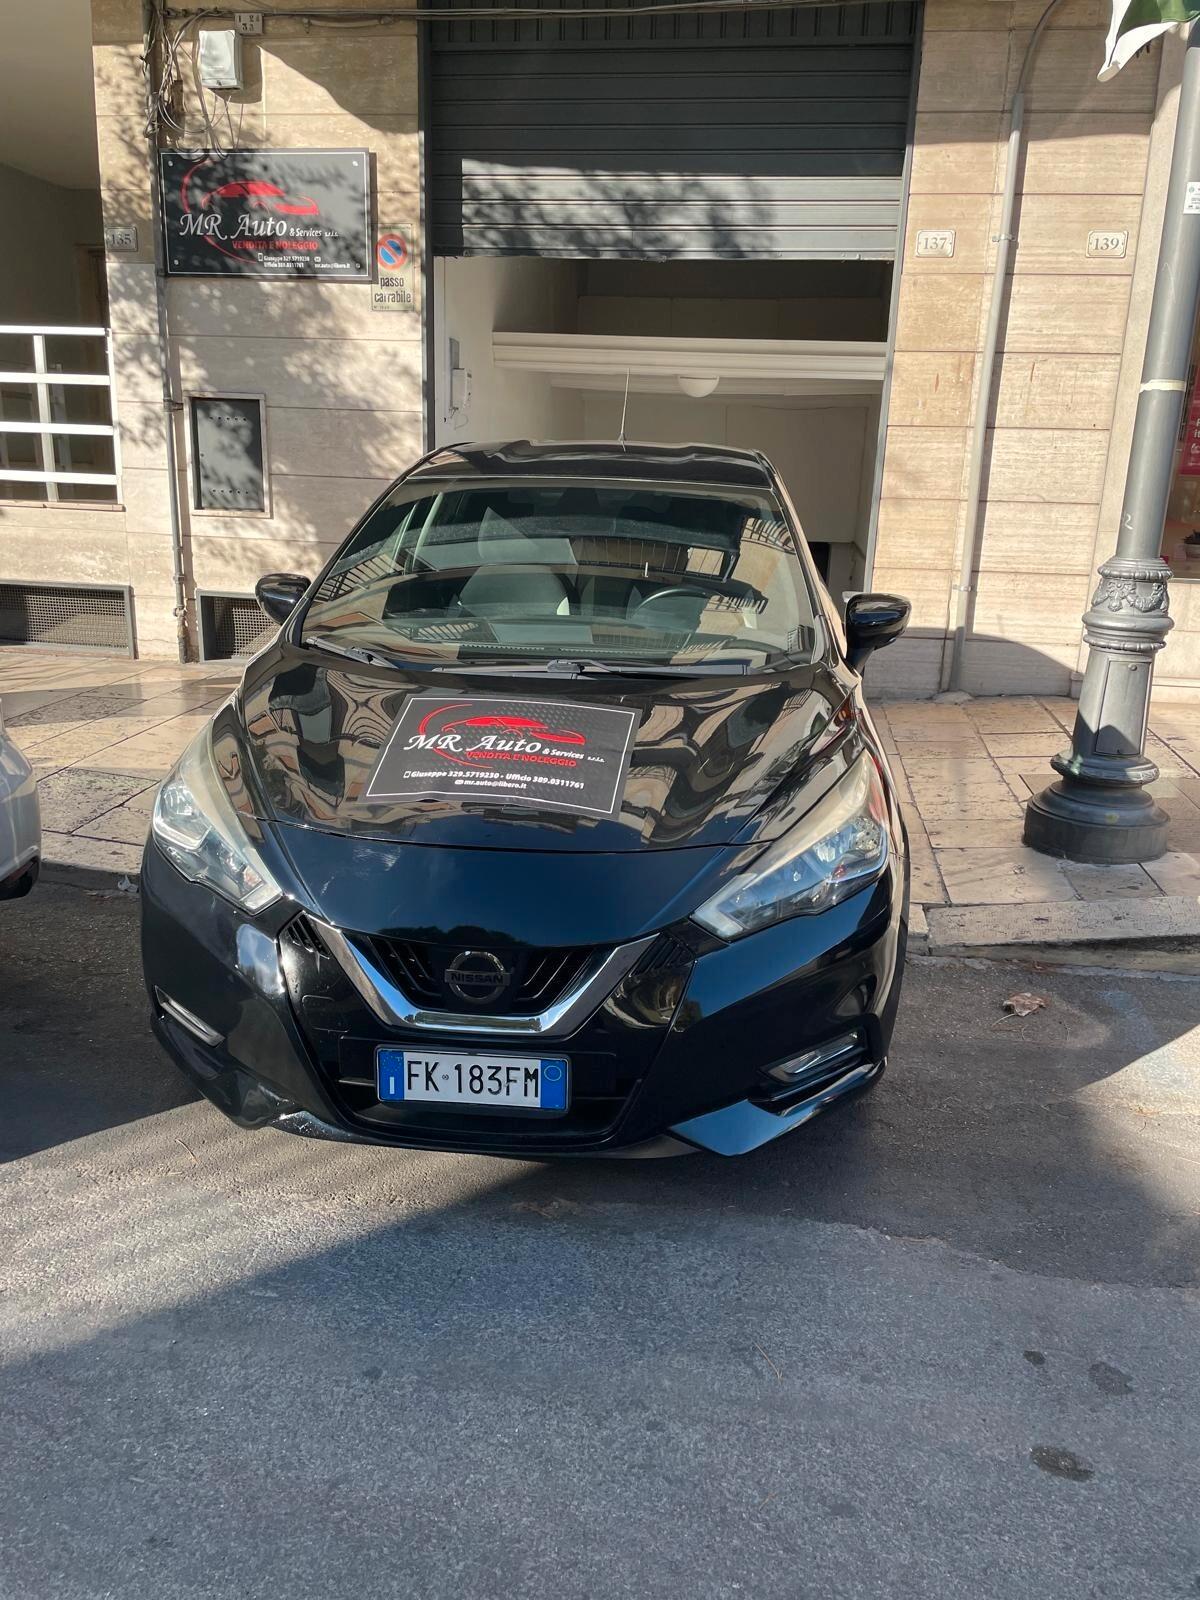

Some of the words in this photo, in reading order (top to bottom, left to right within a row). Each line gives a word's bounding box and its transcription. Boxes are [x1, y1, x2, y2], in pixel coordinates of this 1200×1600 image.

[179, 213, 228, 240] MR
[230, 213, 287, 239] Auto
[296, 227, 322, 237] Services
[232, 241, 267, 250] VENDITA
[275, 241, 319, 251] NOLEGGIO
[923, 237, 948, 250] 137
[1094, 237, 1120, 251] 139
[380, 277, 404, 290] passo
[374, 290, 412, 303] carrabile
[403, 733, 463, 752] MR
[465, 735, 542, 753] Auto
[551, 748, 584, 759] Services
[466, 751, 511, 760] VENDITA
[521, 754, 577, 767] NOLEGGIO
[411, 770, 447, 778] Giuseppe
[505, 773, 532, 782] Ufficio
[463, 780, 527, 789] mr.auto@libero.it
[450, 972, 504, 985] NISSAN
[407, 1060, 440, 1092] FK
[454, 1063, 539, 1098] 183FM
